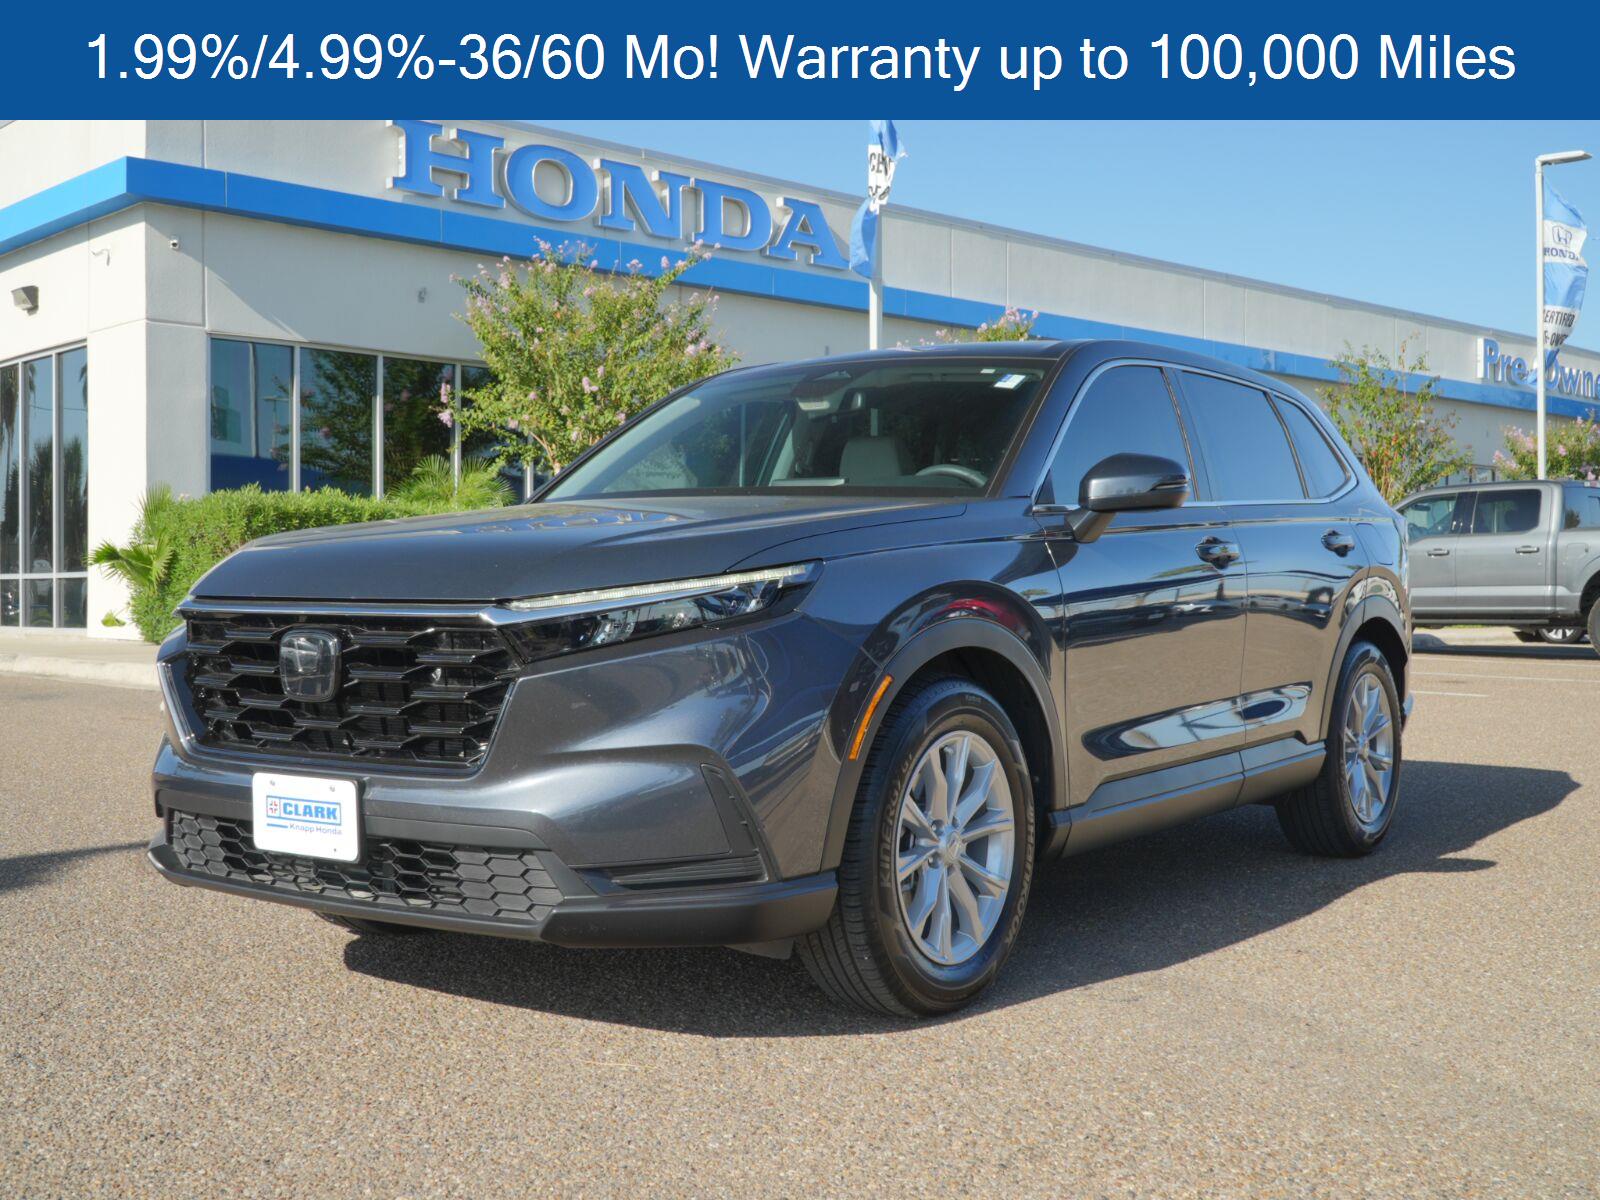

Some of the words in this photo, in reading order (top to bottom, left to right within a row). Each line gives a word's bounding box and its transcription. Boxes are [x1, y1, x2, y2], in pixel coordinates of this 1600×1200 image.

[386, 120, 851, 271] HONDA
[1543, 247, 1579, 261] HOND
[282, 801, 338, 820] CLARK
[289, 823, 315, 833] Knapp
[316, 826, 342, 836] Honda
